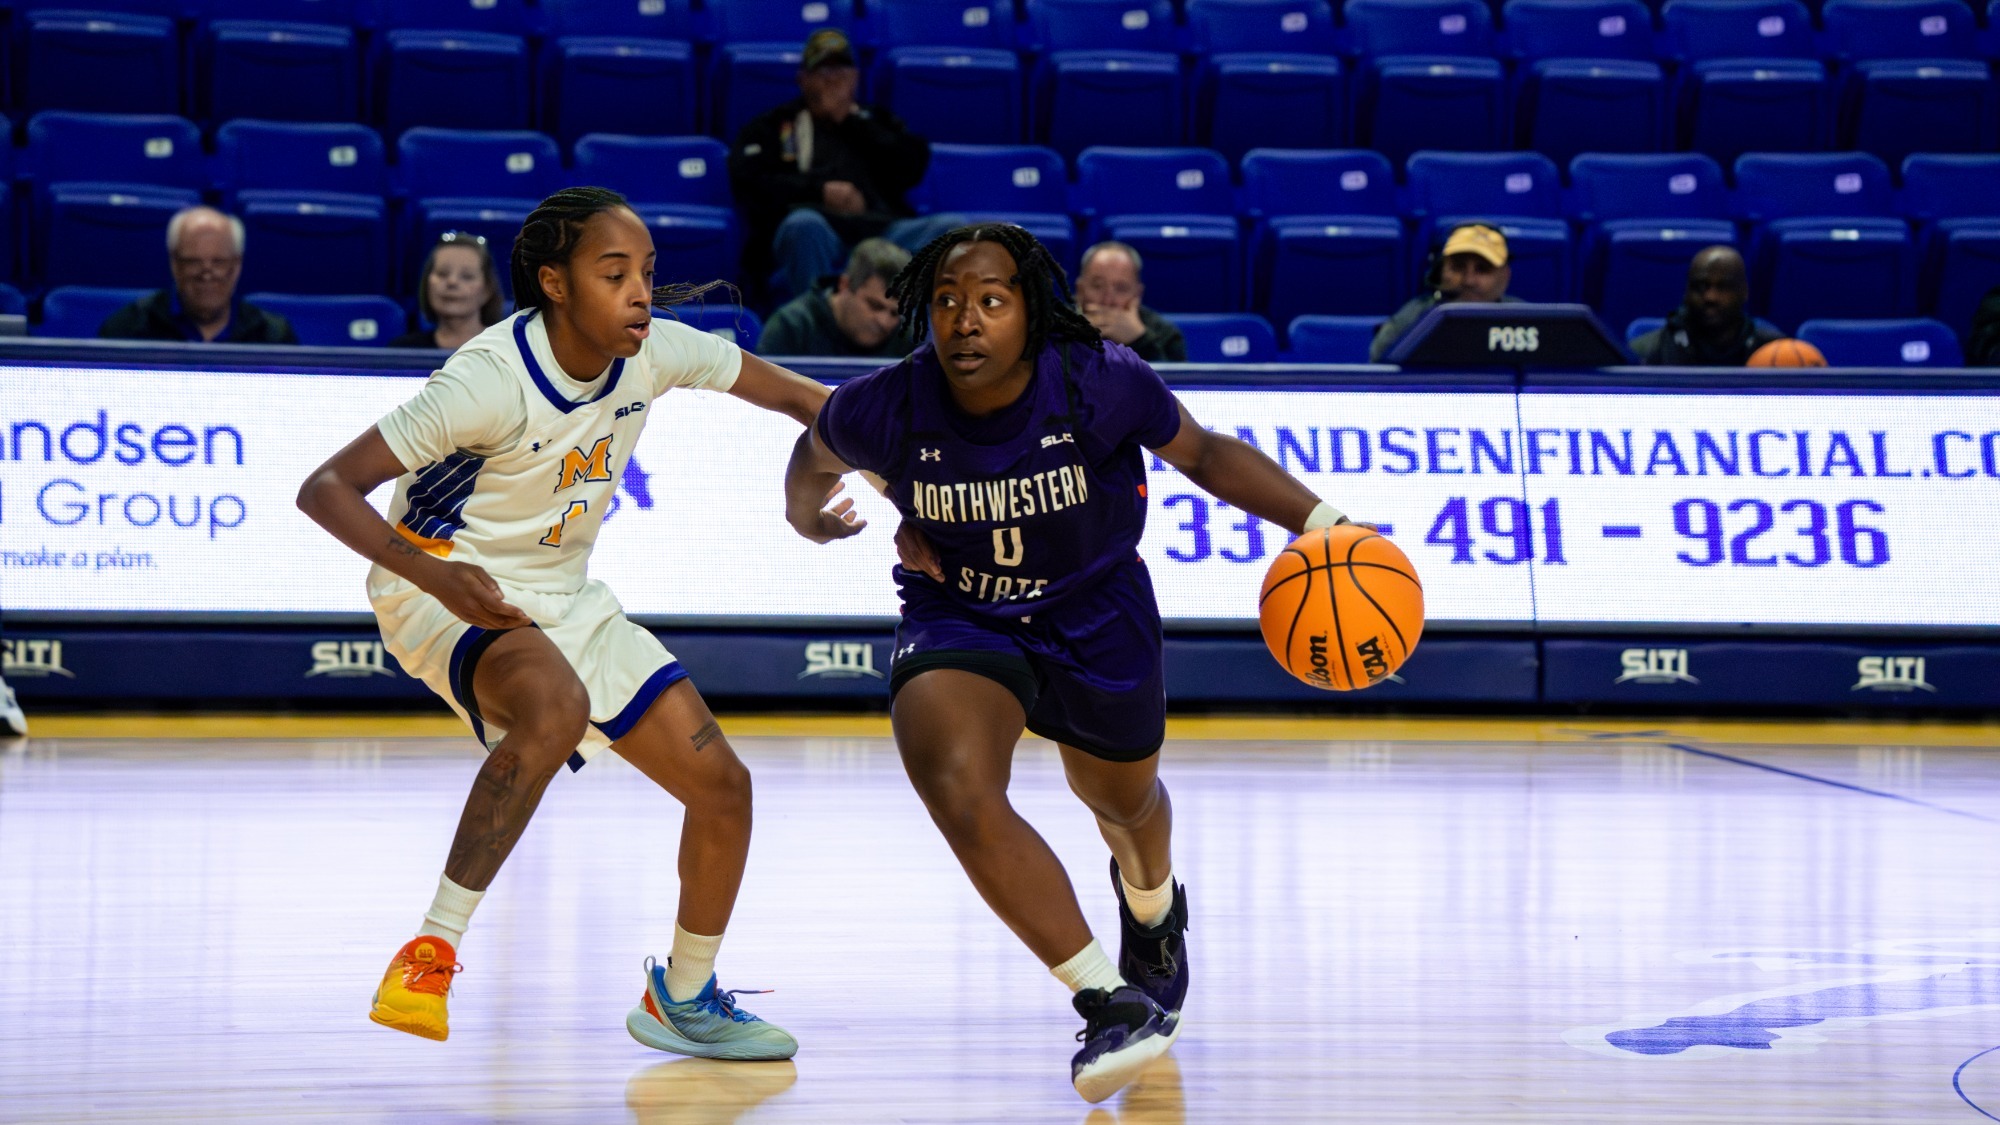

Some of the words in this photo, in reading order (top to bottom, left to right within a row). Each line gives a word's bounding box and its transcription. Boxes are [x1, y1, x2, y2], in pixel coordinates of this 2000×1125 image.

[1488, 326, 1539, 352] POSS
[614, 401, 646, 420] SLC
[0, 408, 245, 467] ndsen
[1040, 432, 1075, 449] SLC
[1150, 425, 2000, 481] NDSENFINANCIAL.C
[553, 433, 614, 493] M
[36, 478, 247, 541] Group
[913, 464, 1088, 523] NORTHWESTERN
[1162, 494, 1300, 564] 33
[1424, 496, 1568, 566] 491
[1672, 498, 1892, 569] 9236
[311, 641, 384, 673] SITI
[804, 641, 874, 672] SITI
[1356, 636, 1389, 684] CAA
[1620, 648, 1688, 679] SITI
[1857, 655, 1926, 687] SITI
